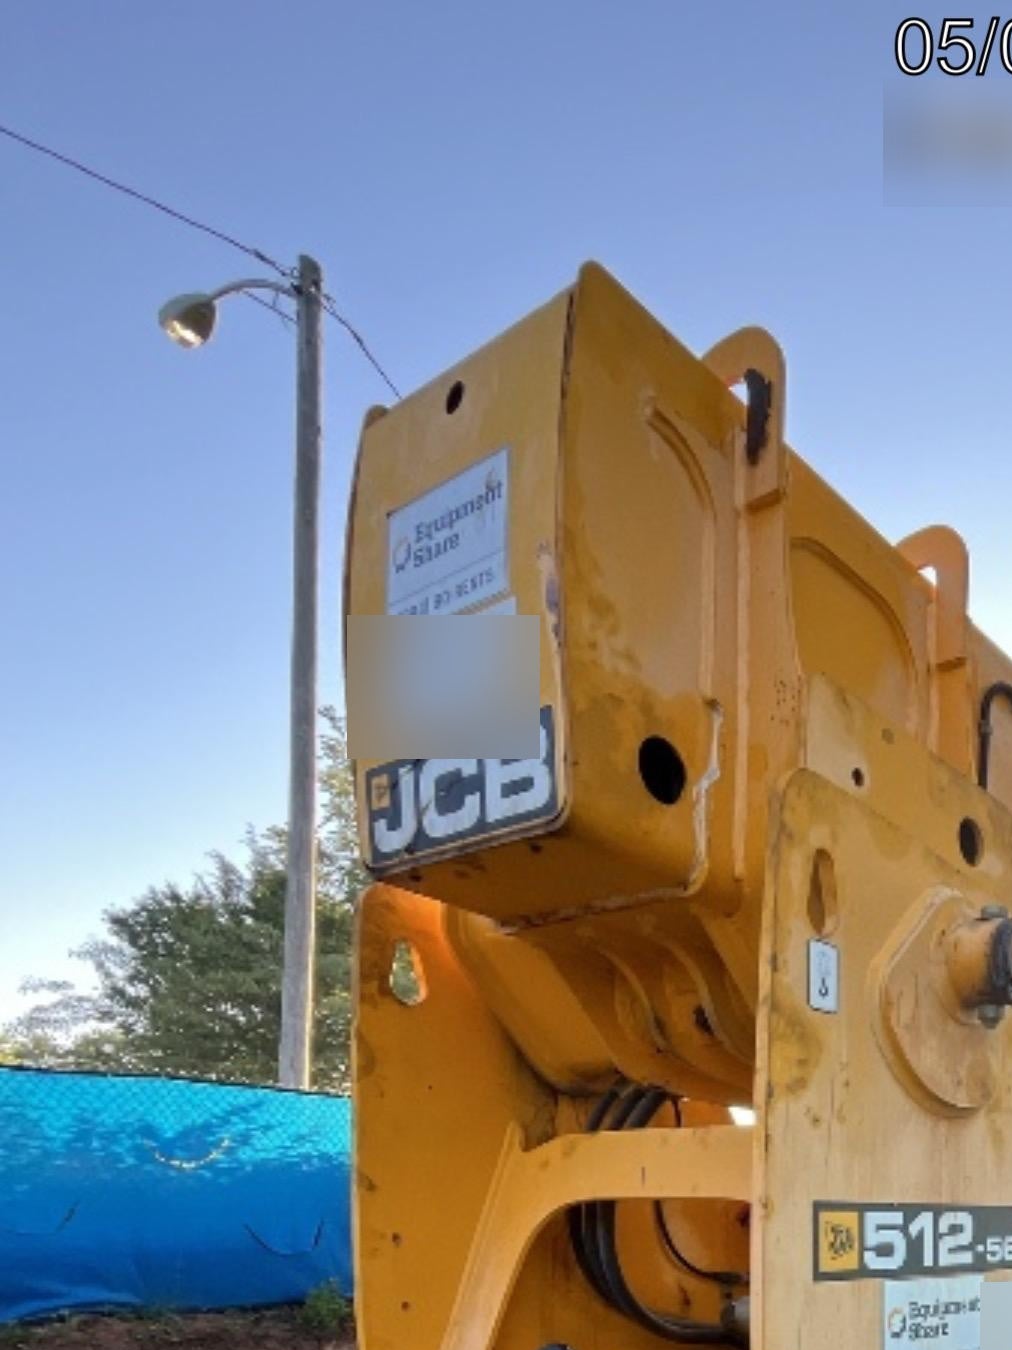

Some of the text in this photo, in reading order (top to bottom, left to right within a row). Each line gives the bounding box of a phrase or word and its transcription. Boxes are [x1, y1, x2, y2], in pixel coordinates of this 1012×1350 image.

[415, 479, 502, 544] Equipment
[413, 533, 460, 568] Share
[373, 722, 551, 853] JCB
